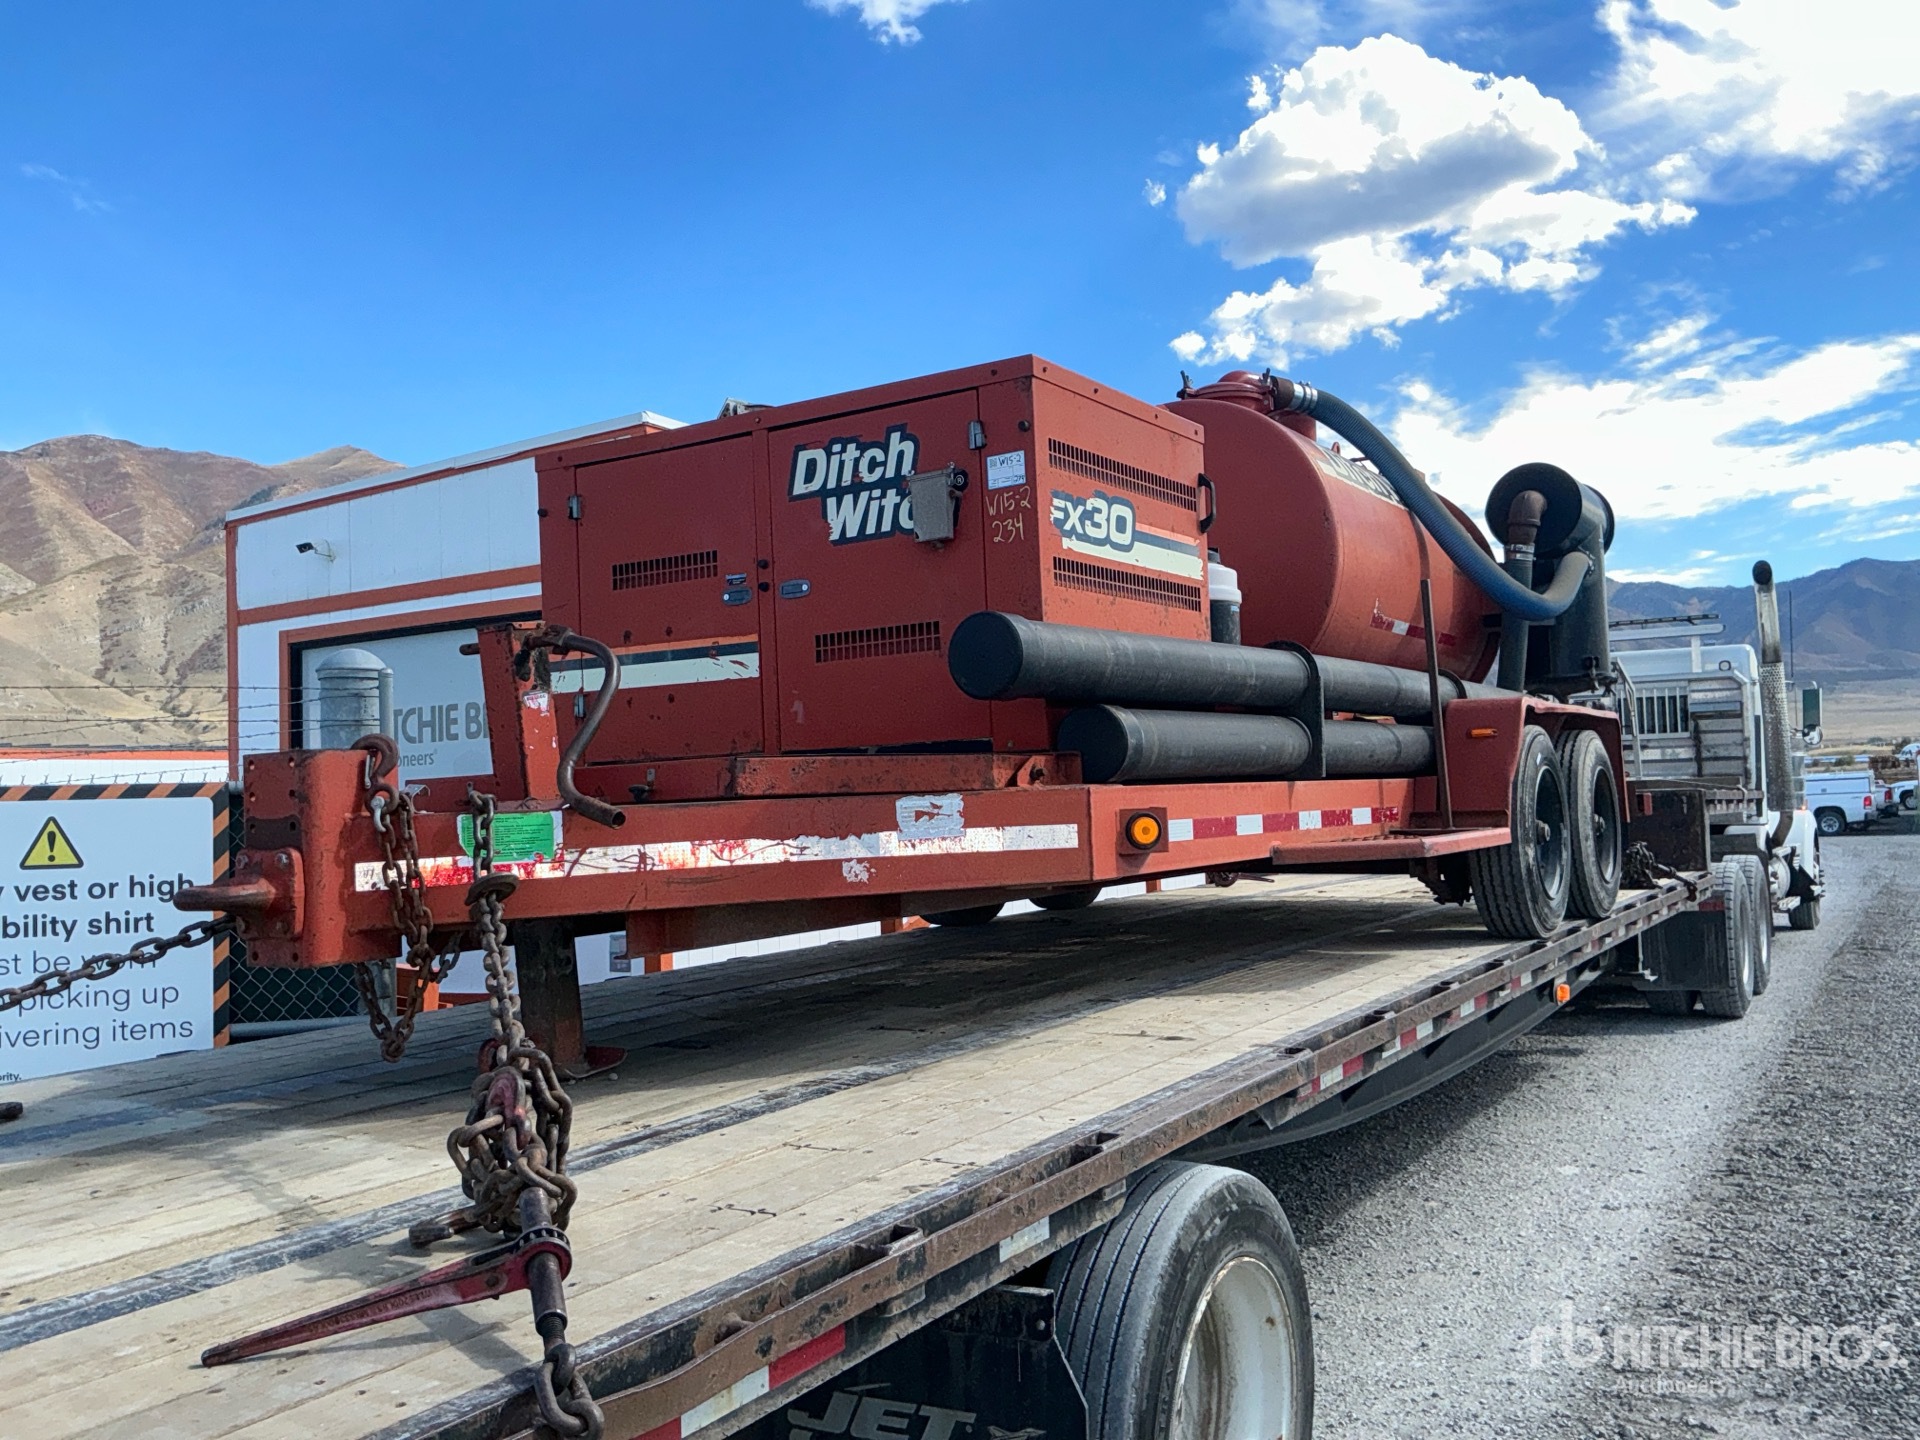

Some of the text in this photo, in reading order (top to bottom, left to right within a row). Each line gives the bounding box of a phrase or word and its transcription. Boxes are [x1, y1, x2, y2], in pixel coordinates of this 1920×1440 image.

[793, 431, 915, 496] Ditch
[826, 489, 915, 541] Wit
[986, 486, 1031, 516] W15-2
[992, 513, 1024, 543] 234
[393, 703, 459, 744] TCHIE
[13, 880, 78, 902] vest
[87, 882, 119, 899] or
[129, 873, 193, 903] high
[2, 910, 154, 942] bility shirt
[33, 950, 71, 974] be
[18, 984, 179, 1017] picking up
[112, 1019, 193, 1042] items
[788, 1391, 977, 1440] JET
